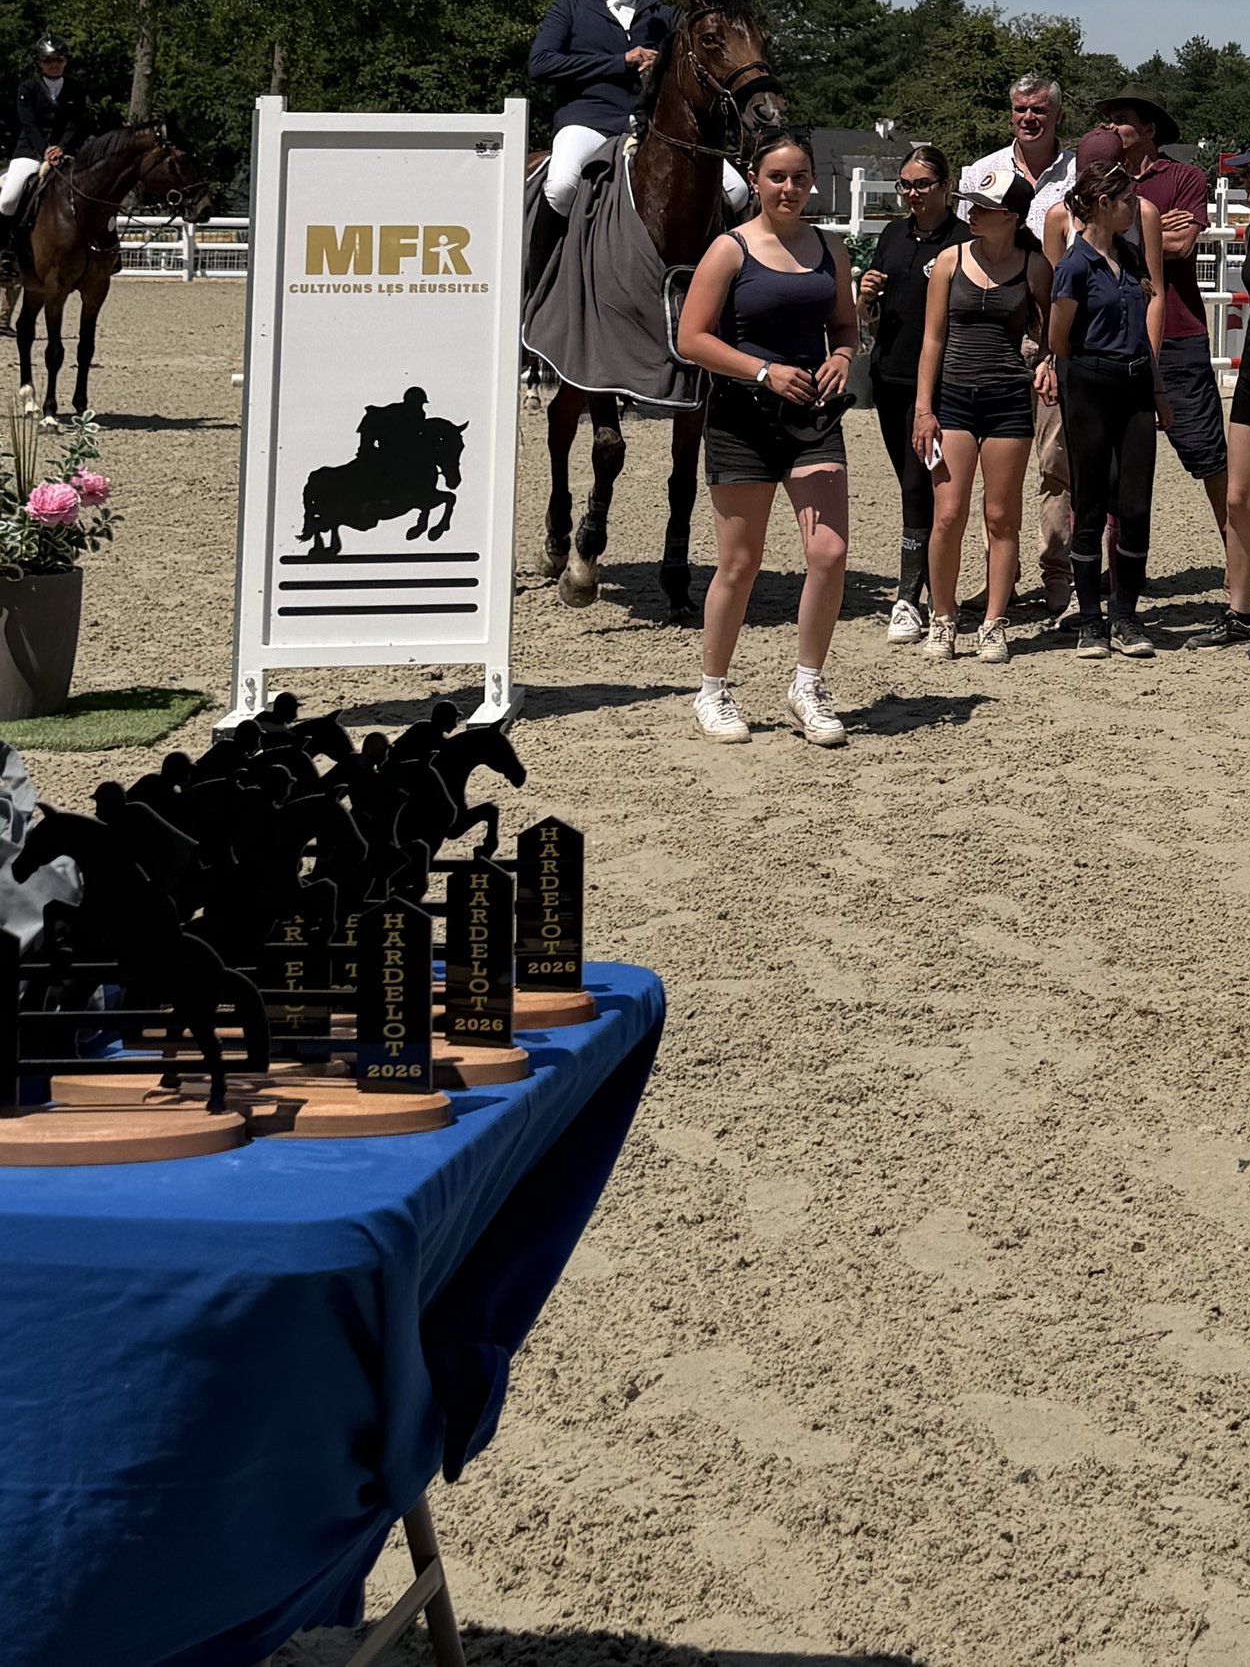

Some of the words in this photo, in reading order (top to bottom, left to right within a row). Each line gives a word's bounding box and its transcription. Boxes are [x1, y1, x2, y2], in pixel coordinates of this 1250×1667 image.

[305, 225, 472, 275] MFR
[289, 283, 373, 294] CULTIVONS
[377, 283, 404, 294] LES
[409, 279, 489, 294] RÉUSSITES
[539, 827, 562, 955] HARDELOT
[469, 873, 490, 1011] HARDELOT
[527, 961, 577, 974] 2026
[382, 913, 406, 1057] HARDELOT
[454, 1018, 504, 1031] 2026
[367, 1064, 422, 1077] 2026
